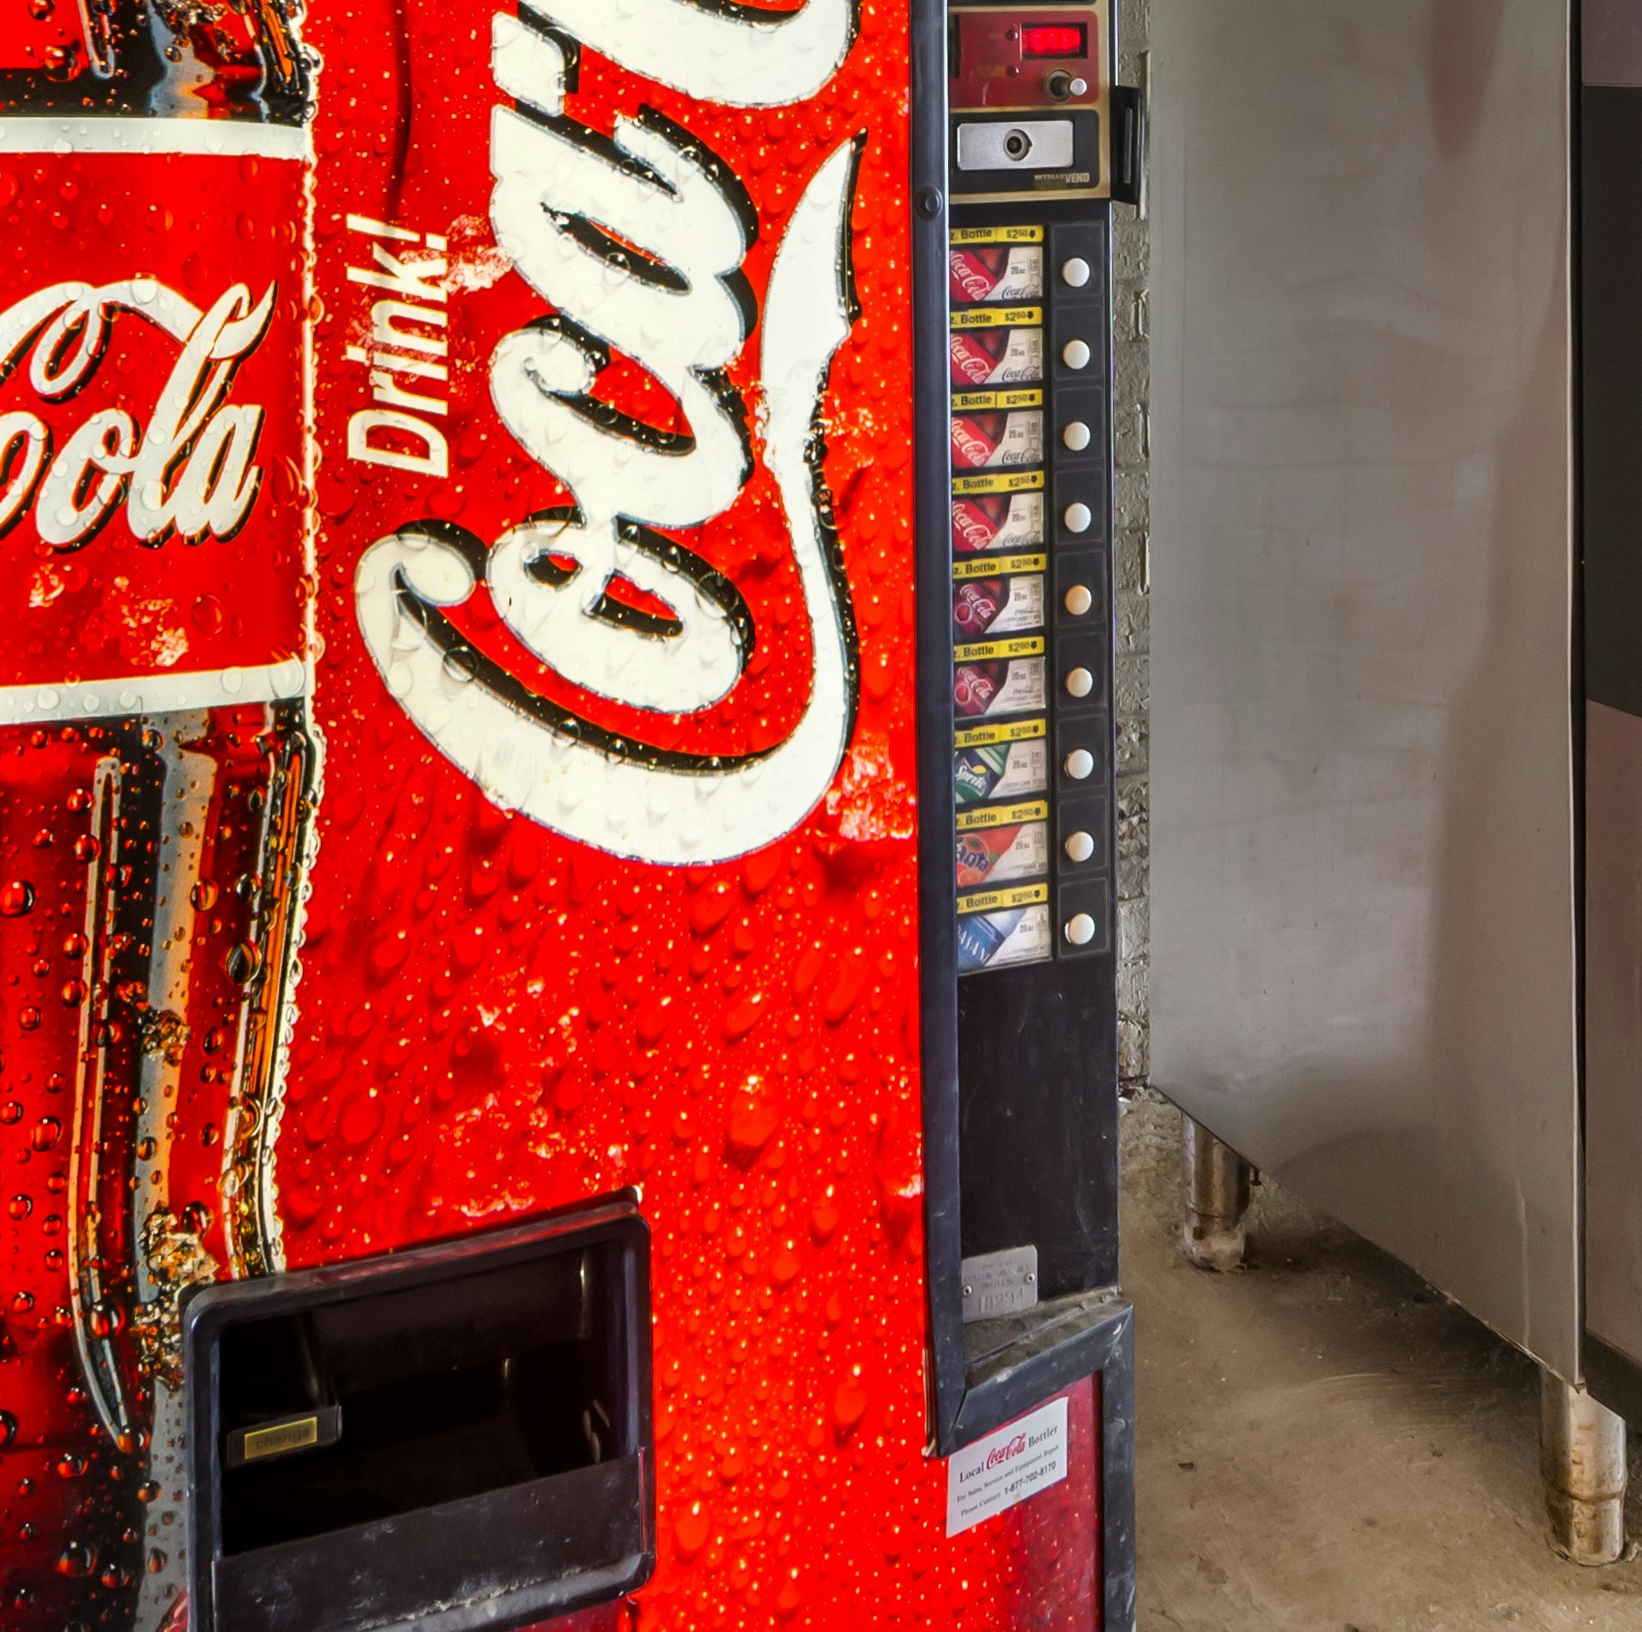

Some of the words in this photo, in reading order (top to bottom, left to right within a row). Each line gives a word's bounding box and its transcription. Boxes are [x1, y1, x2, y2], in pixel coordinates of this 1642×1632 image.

[961, 229, 992, 240] Bottle
[960, 313, 992, 324] Bottle
[346, 213, 449, 479] Drink!
[961, 395, 992, 406] Bottle
[963, 478, 994, 489] Bottle
[965, 562, 996, 574] Bottle
[963, 645, 994, 657] Bottle
[964, 732, 995, 743] Bottle
[956, 764, 988, 789] Sprite
[965, 813, 997, 825] Bottle
[956, 843, 990, 872] anta
[966, 894, 997, 908] Bottle
[255, 1427, 312, 1450] change
[959, 1461, 984, 1483] Local
[1028, 1425, 1059, 1449] Bottler
[1004, 1467, 1014, 1478] and
[960, 1504, 978, 1517] Please
